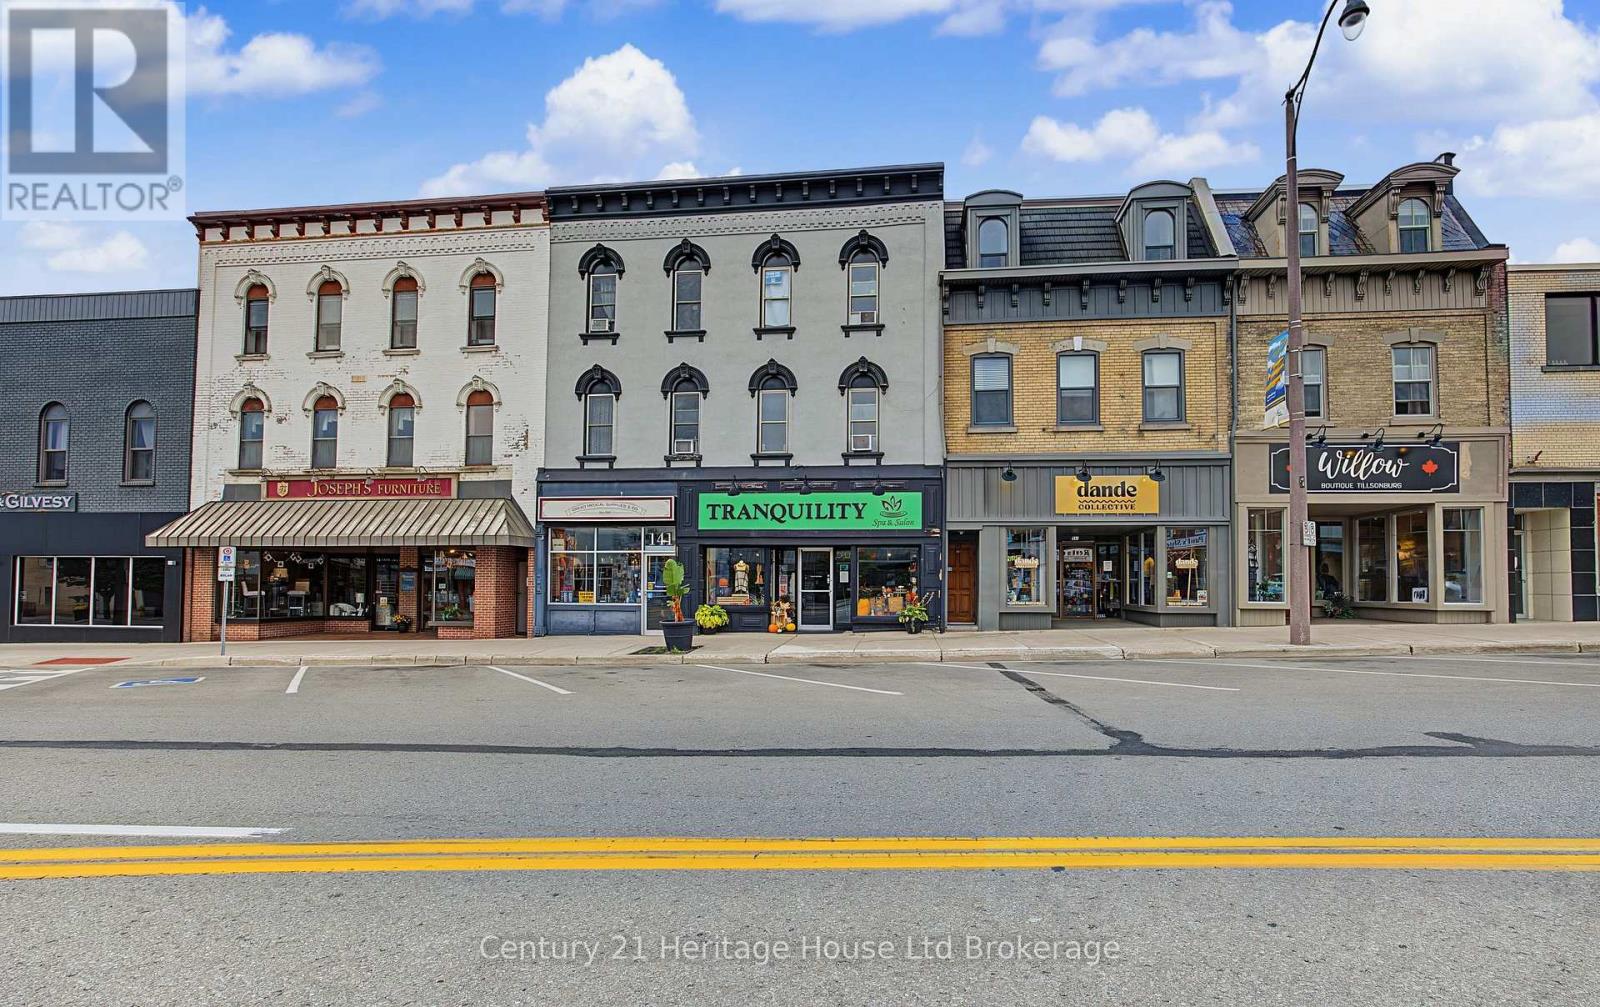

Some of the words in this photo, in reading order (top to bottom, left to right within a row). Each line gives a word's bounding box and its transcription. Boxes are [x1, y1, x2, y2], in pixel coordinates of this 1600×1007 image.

[1318, 449, 1410, 480] Willow
[307, 480, 372, 497] JOSEPH'S
[377, 482, 441, 495] FURNITURE
[1077, 480, 1137, 497] dande
[5, 494, 75, 509] GILVESY
[706, 503, 868, 524] TRANQUILITY
[872, 518, 887, 528] Spa
[894, 518, 915, 527] Salon
[649, 531, 673, 546] 141
